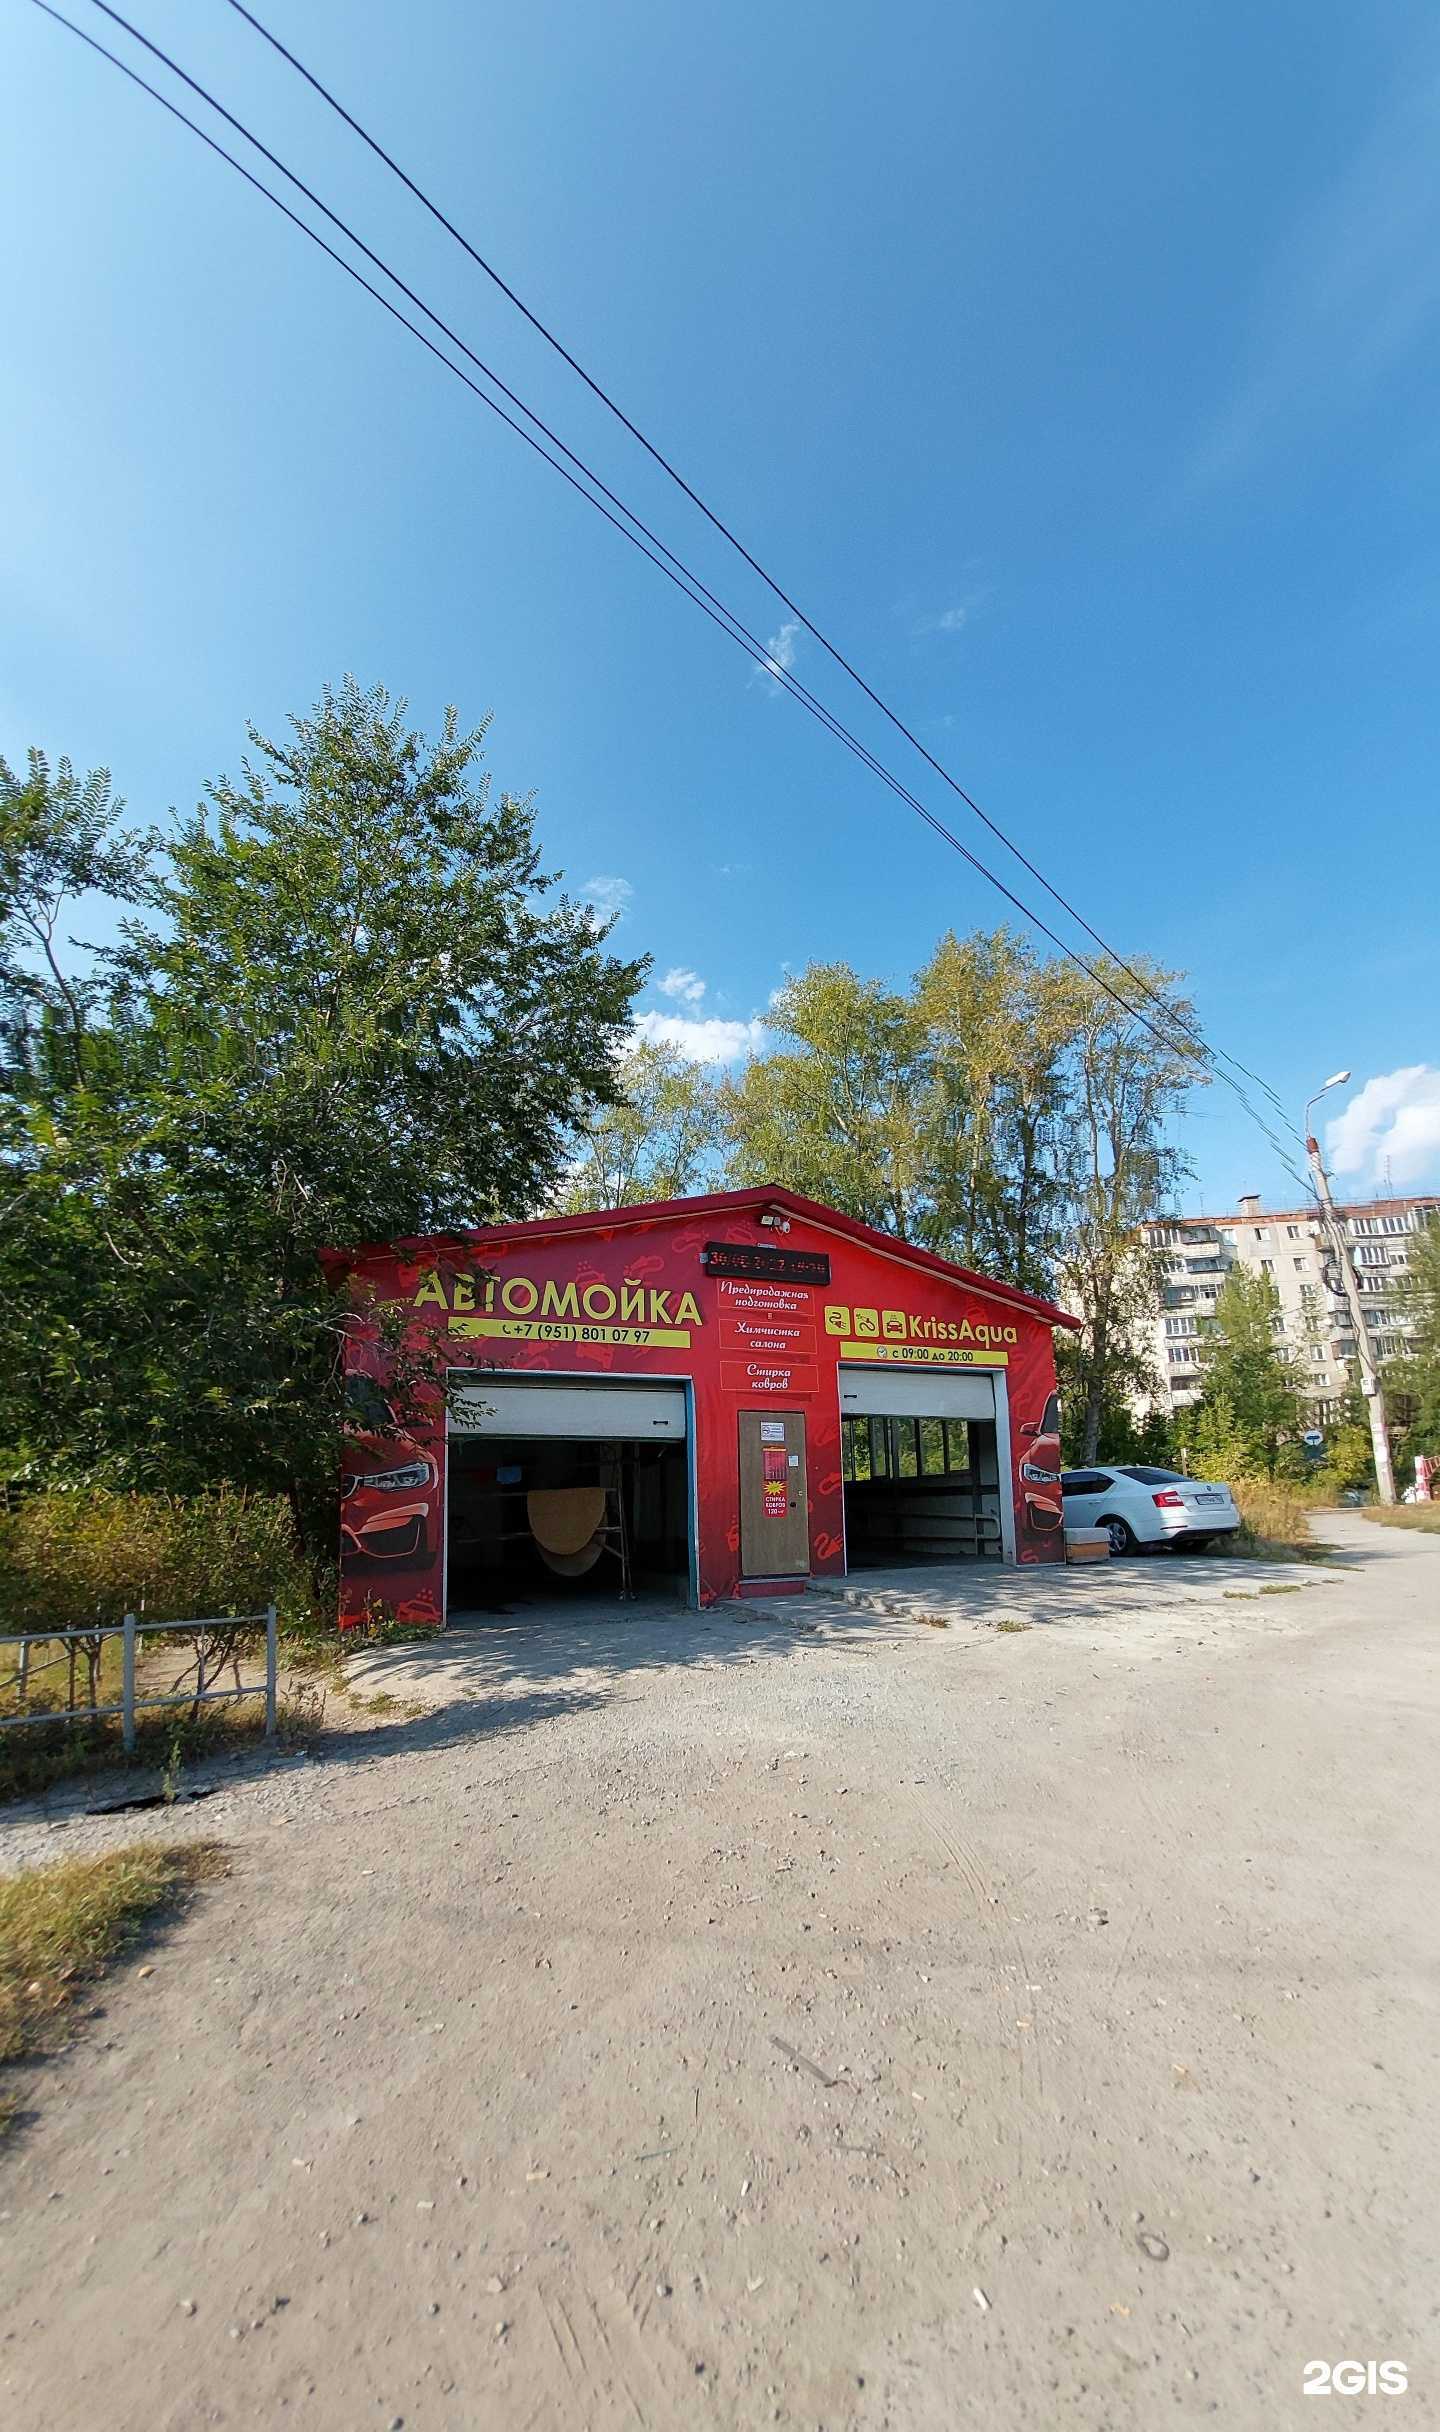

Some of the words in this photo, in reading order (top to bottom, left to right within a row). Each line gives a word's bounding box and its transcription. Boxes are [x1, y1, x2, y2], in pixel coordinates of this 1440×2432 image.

[720, 1280, 809, 1300] Предпродажная
[414, 1270, 704, 1327] АВТОМОЙКА
[735, 1297, 797, 1311] подготовка
[514, 1323, 532, 1337] +7
[537, 1324, 577, 1342] (951)
[581, 1327, 606, 1341] 801
[612, 1329, 629, 1342] 07
[634, 1330, 650, 1343] 97
[734, 1322, 801, 1338] Химчистка
[909, 1315, 1017, 1349] KrissAqua
[750, 1339, 786, 1350] салона
[902, 1348, 929, 1359] 09:00
[948, 1352, 973, 1361] 20:00
[746, 1363, 791, 1378] Стирка
[752, 1378, 789, 1391] ковров
